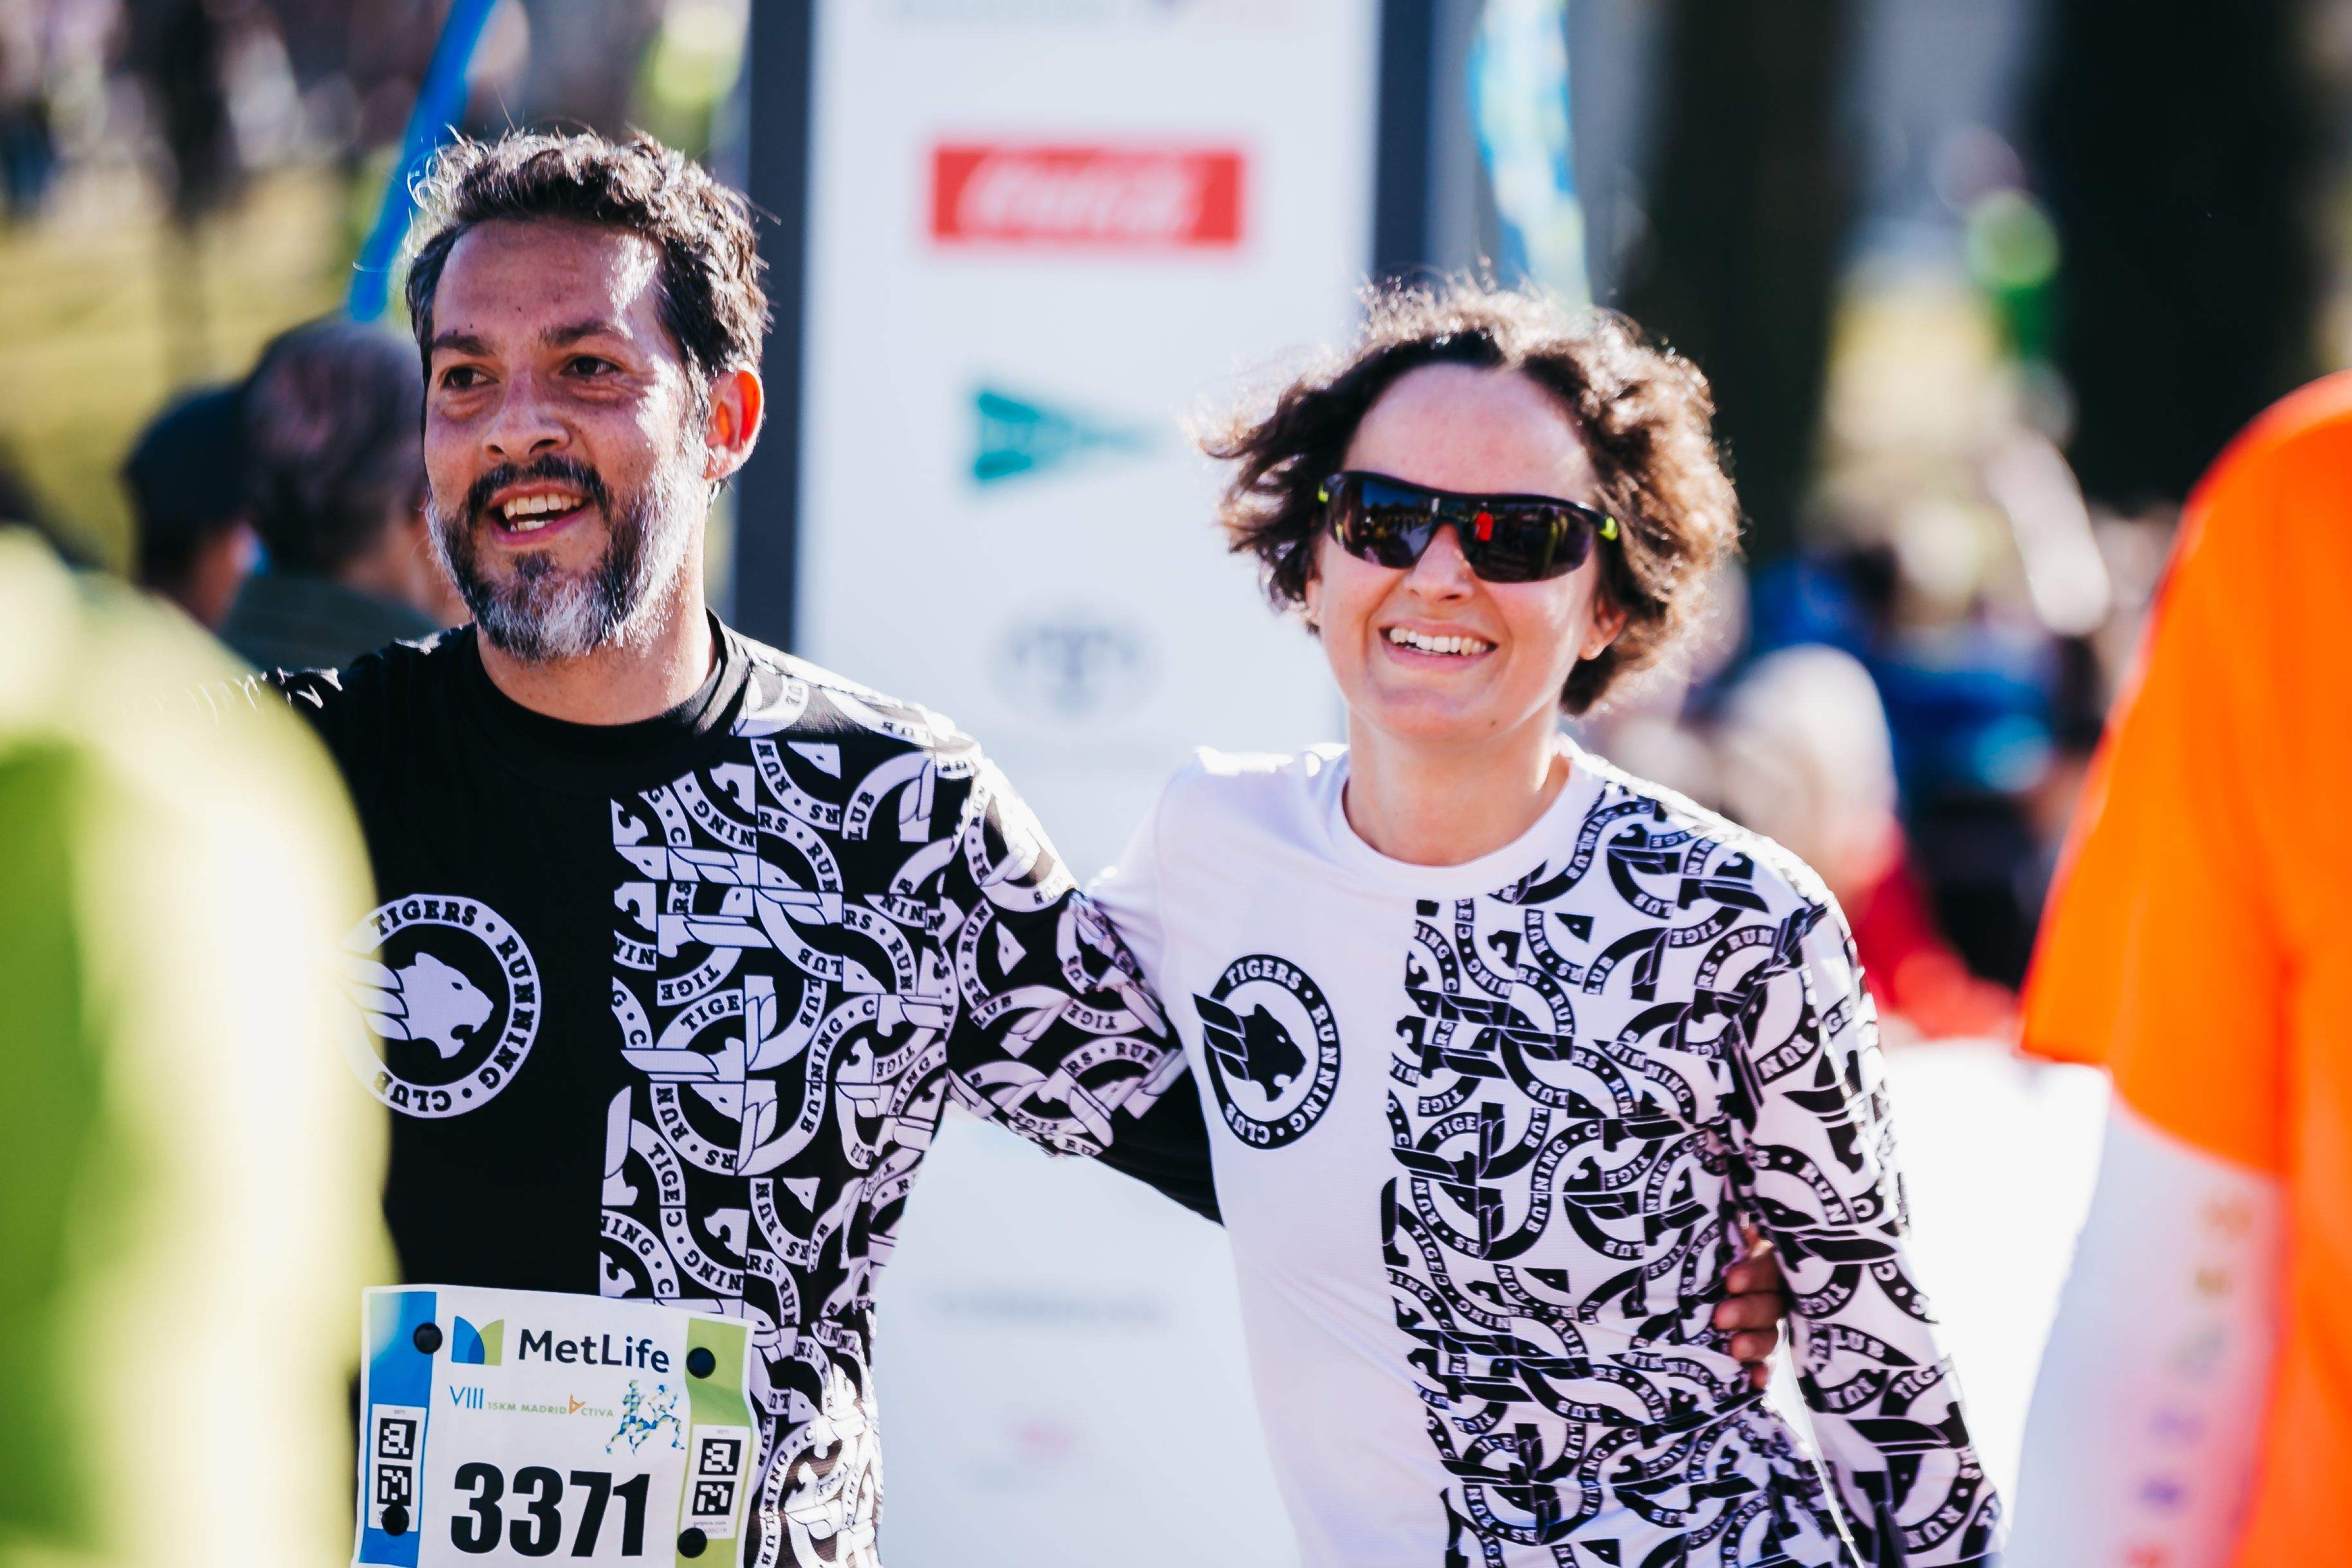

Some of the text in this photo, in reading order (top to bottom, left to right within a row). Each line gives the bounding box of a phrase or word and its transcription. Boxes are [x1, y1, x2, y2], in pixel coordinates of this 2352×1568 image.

[759, 812, 789, 834] RS
[844, 909, 873, 930] RS
[370, 900, 477, 936] TIGERS
[478, 934, 535, 1089] RUNNING
[680, 995, 741, 1032] TIGE
[810, 1017, 843, 1081] NING
[1225, 960, 1338, 1144] TIGERS RUNNING CLUB
[1432, 1117, 1477, 1140] TIGE
[1534, 1139, 1569, 1190] NING
[519, 1329, 670, 1373] MetLife
[449, 1385, 483, 1410] VIII
[487, 1401, 516, 1411] 15KM
[520, 1403, 567, 1415] MADRID
[451, 1462, 650, 1557] 3371
